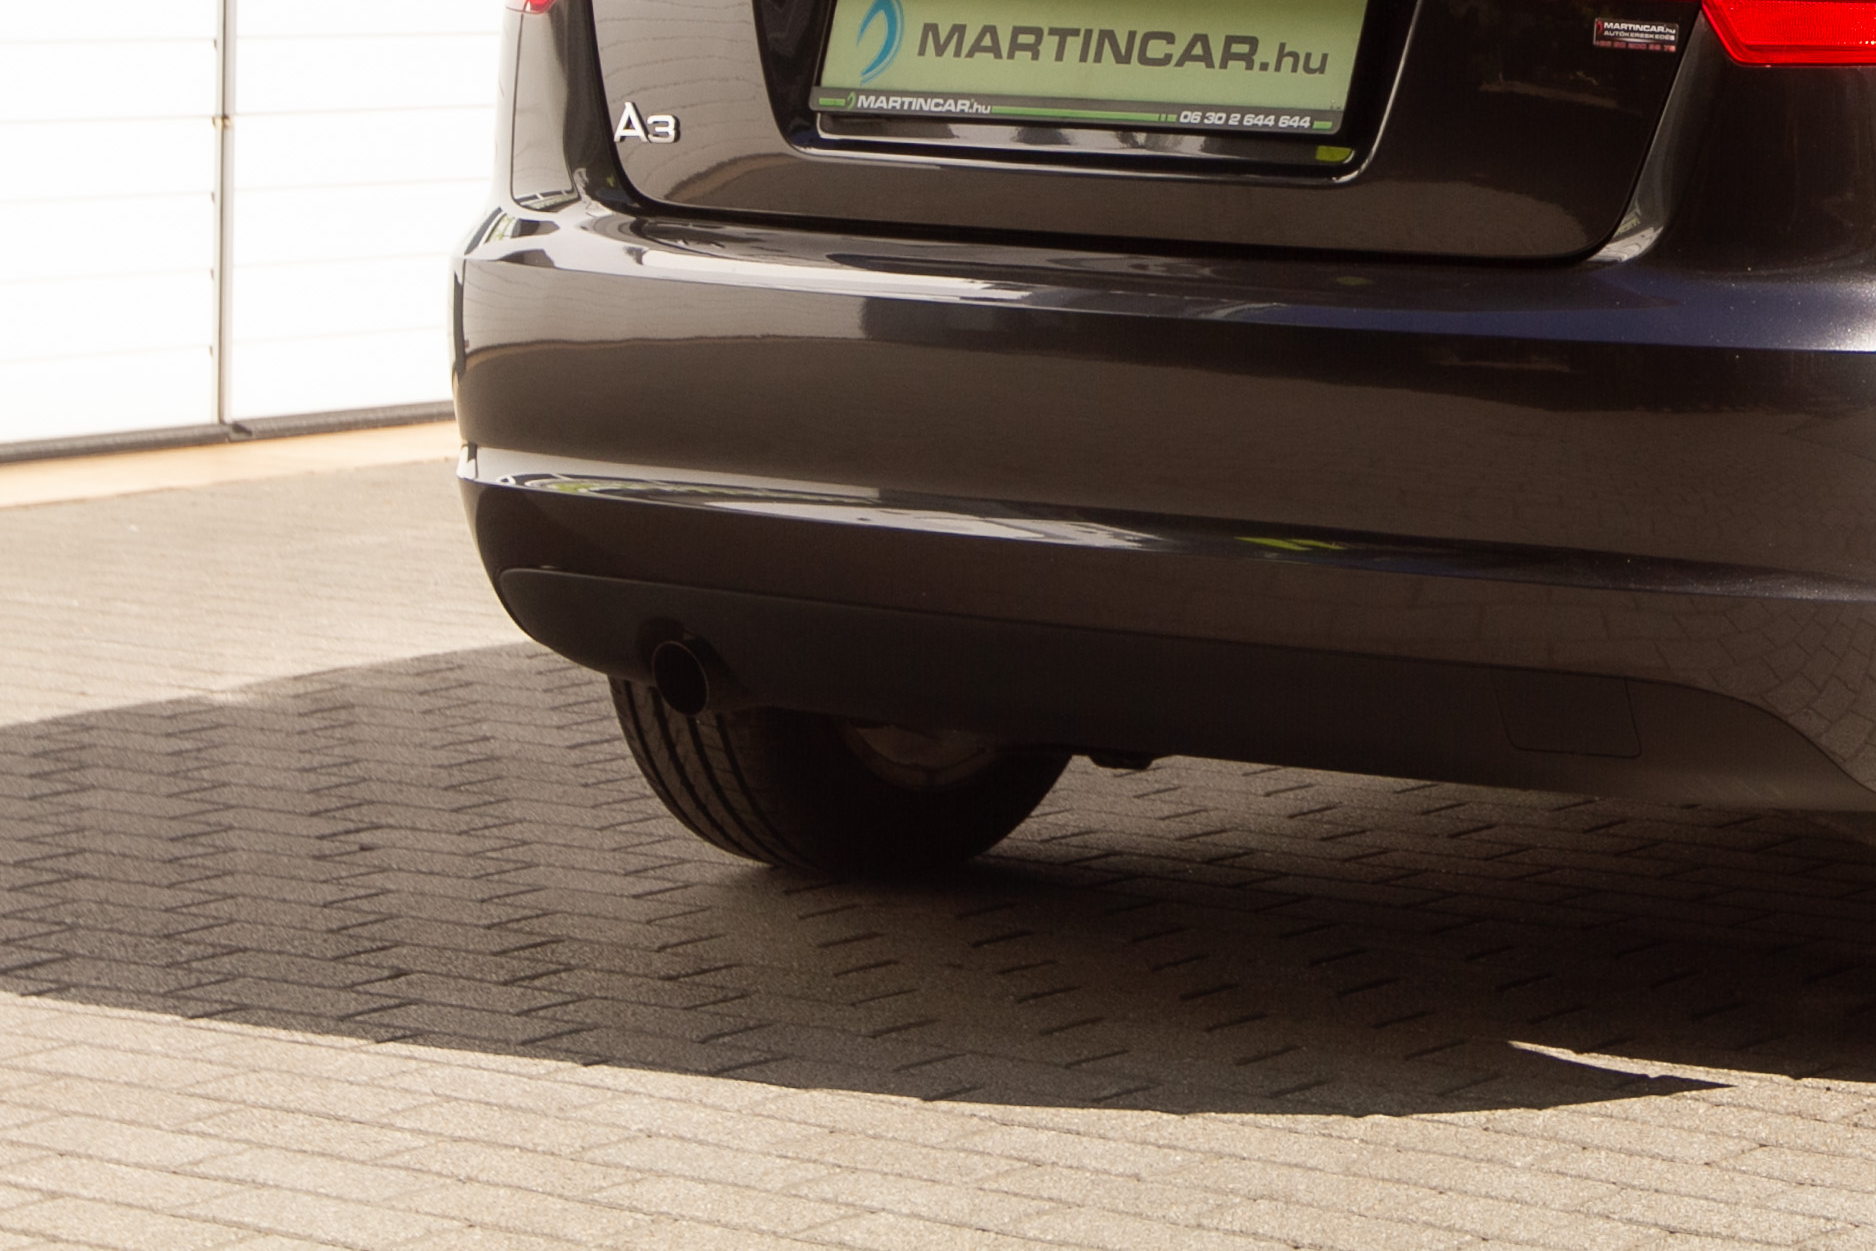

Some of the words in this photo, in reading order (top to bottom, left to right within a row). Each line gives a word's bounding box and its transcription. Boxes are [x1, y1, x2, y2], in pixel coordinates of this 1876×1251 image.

[1603, 22, 1676, 34] MARTINCAR.hu
[916, 22, 1329, 75] MARTINCAR.hu
[857, 94, 991, 114] MARTINCAR.hu
[613, 101, 677, 144] A3
[1179, 111, 1201, 124] 06
[1204, 112, 1226, 125] 30
[1228, 113, 1241, 126] 2
[1243, 113, 1275, 127] 644
[1278, 115, 1311, 129] 644
